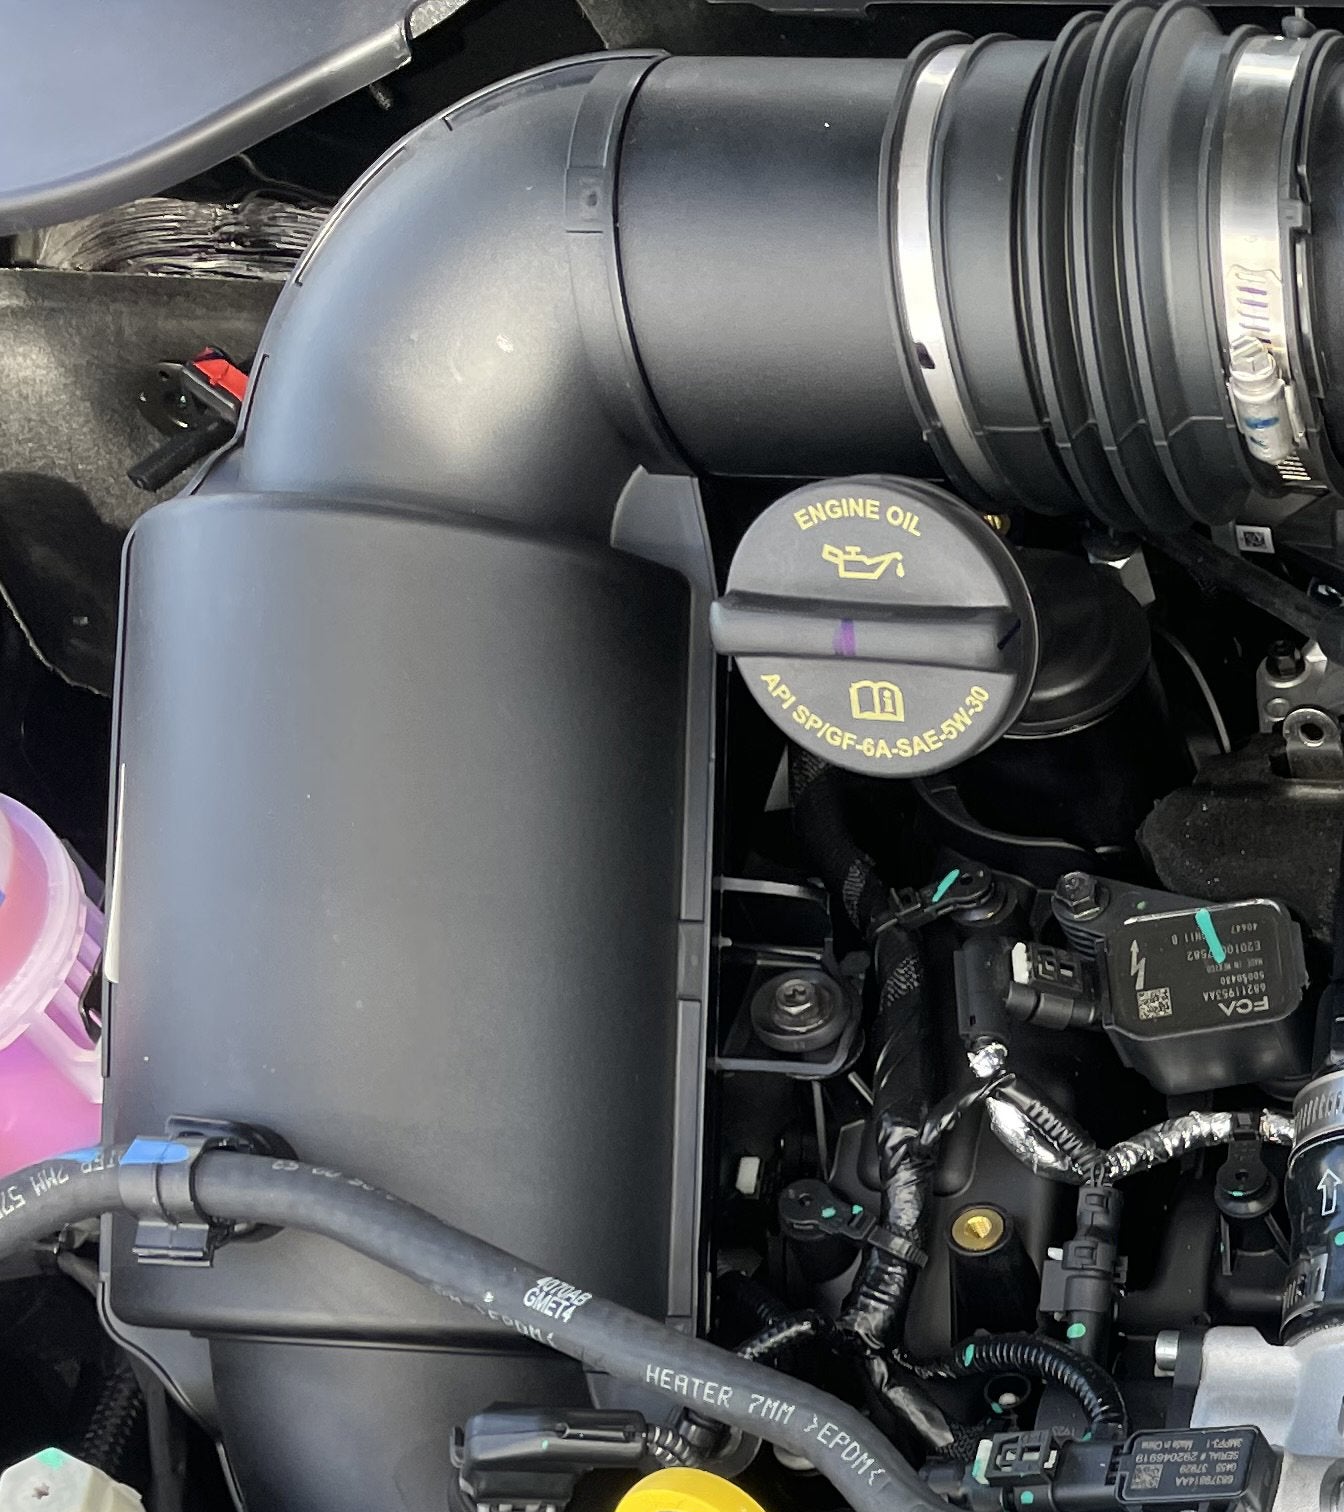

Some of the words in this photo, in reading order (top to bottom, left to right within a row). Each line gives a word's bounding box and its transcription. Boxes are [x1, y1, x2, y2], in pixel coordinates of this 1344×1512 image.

[793, 498, 880, 531] ENGINE
[886, 505, 922, 536] OIL
[761, 674, 796, 709] API
[792, 685, 990, 759] SP/GF-6A-SAE-5W-30
[1206, 962, 1231, 973] MEXICO
[1233, 960, 1242, 968] IN
[1217, 995, 1270, 1016] FCA
[646, 1363, 733, 1408] HEATER
[748, 1393, 795, 1425] 7MM
[1141, 1441, 1163, 1450] China
[1164, 1441, 1171, 1449] in
[1172, 1440, 1194, 1450] Made
[1208, 1451, 1239, 1460] SERIAL
